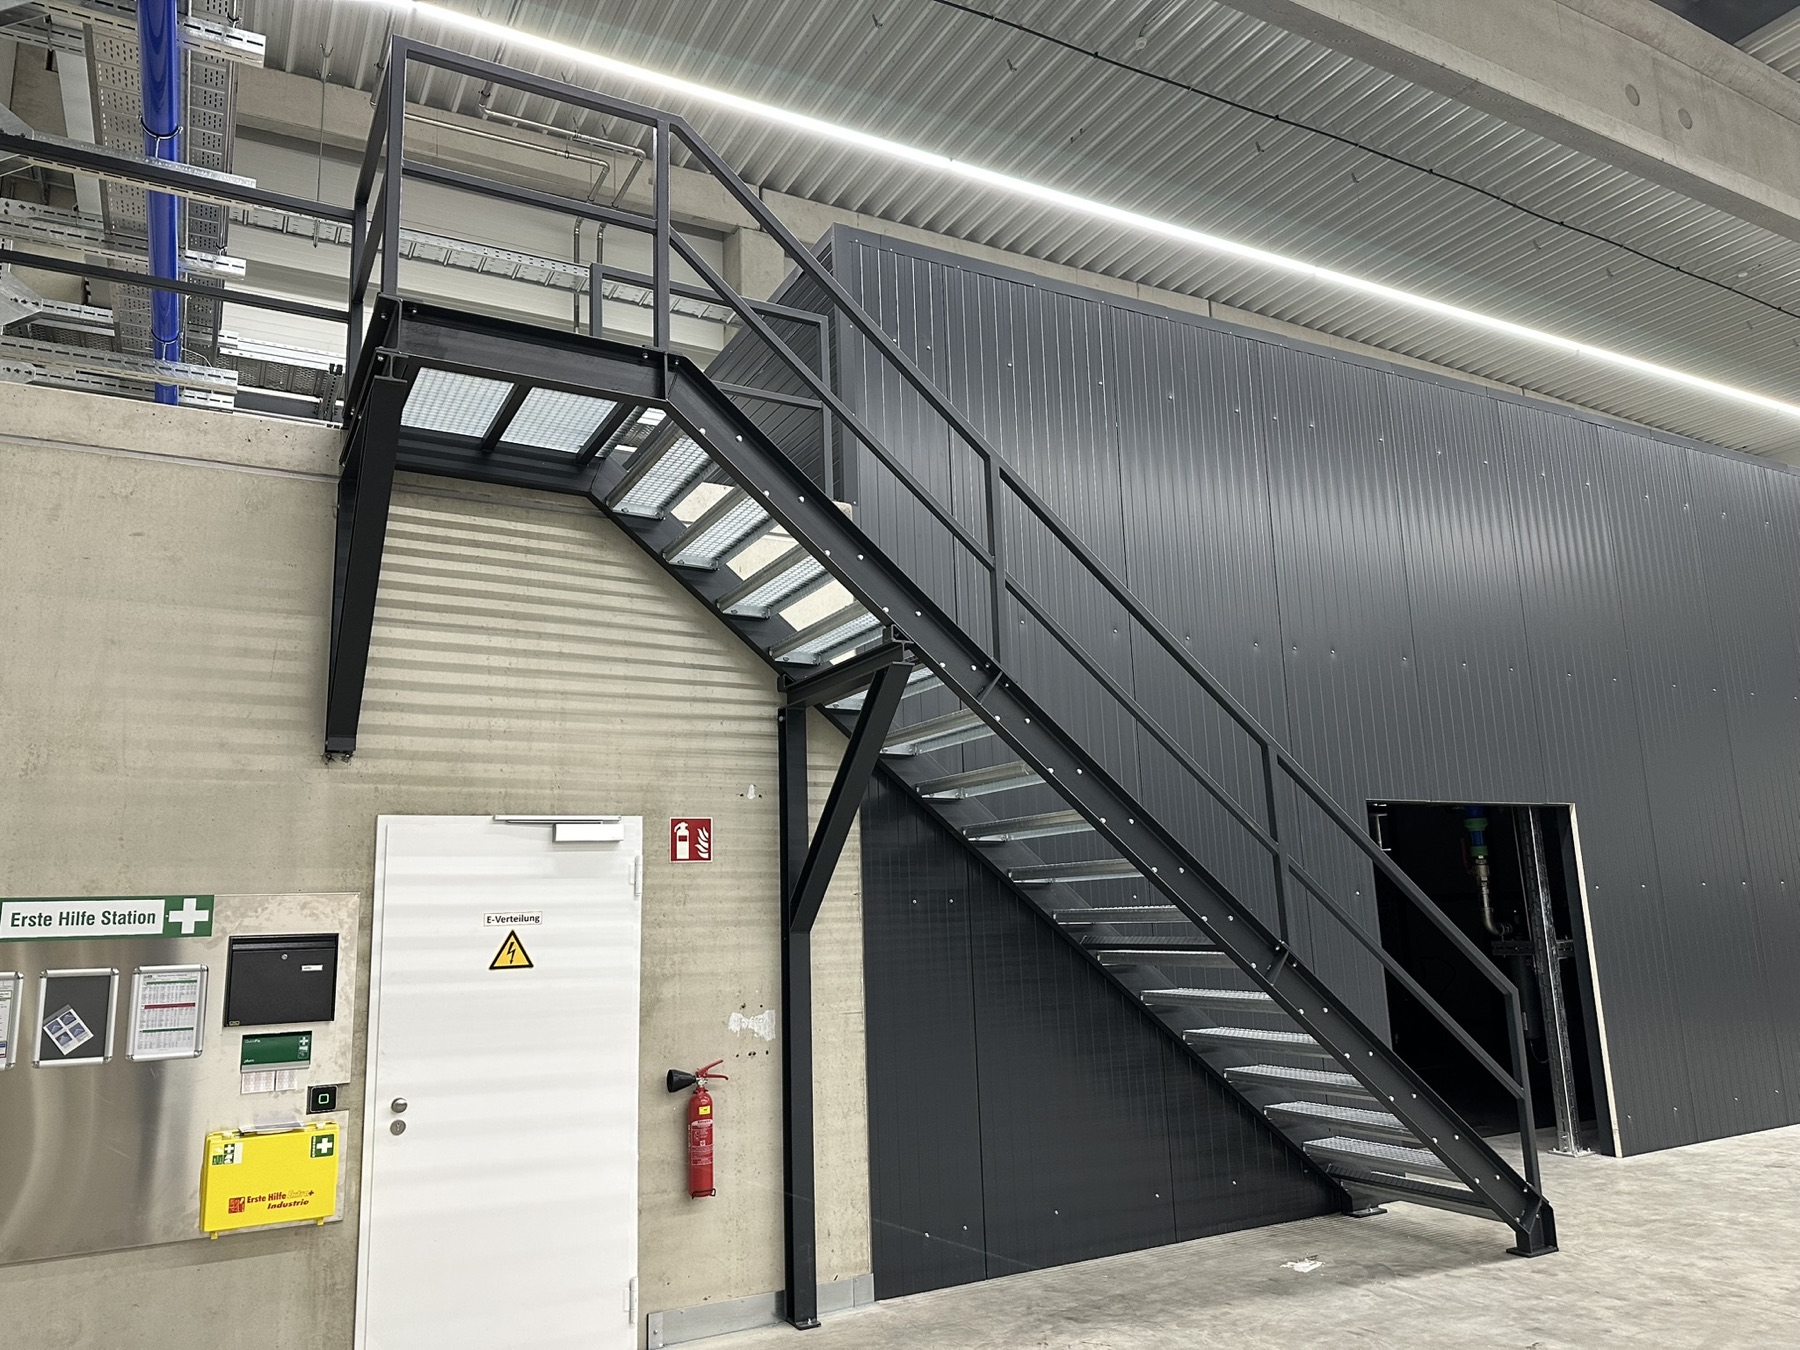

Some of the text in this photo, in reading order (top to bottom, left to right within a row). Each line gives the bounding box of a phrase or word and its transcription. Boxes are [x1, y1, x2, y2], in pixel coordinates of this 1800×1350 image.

[10, 910, 156, 927] Erste Hilfe Station
[486, 914, 540, 923] E-Verteilung
[246, 1195, 267, 1204] Erste
[267, 1192, 287, 1202] Hilfe
[267, 1199, 310, 1210] Industrie
